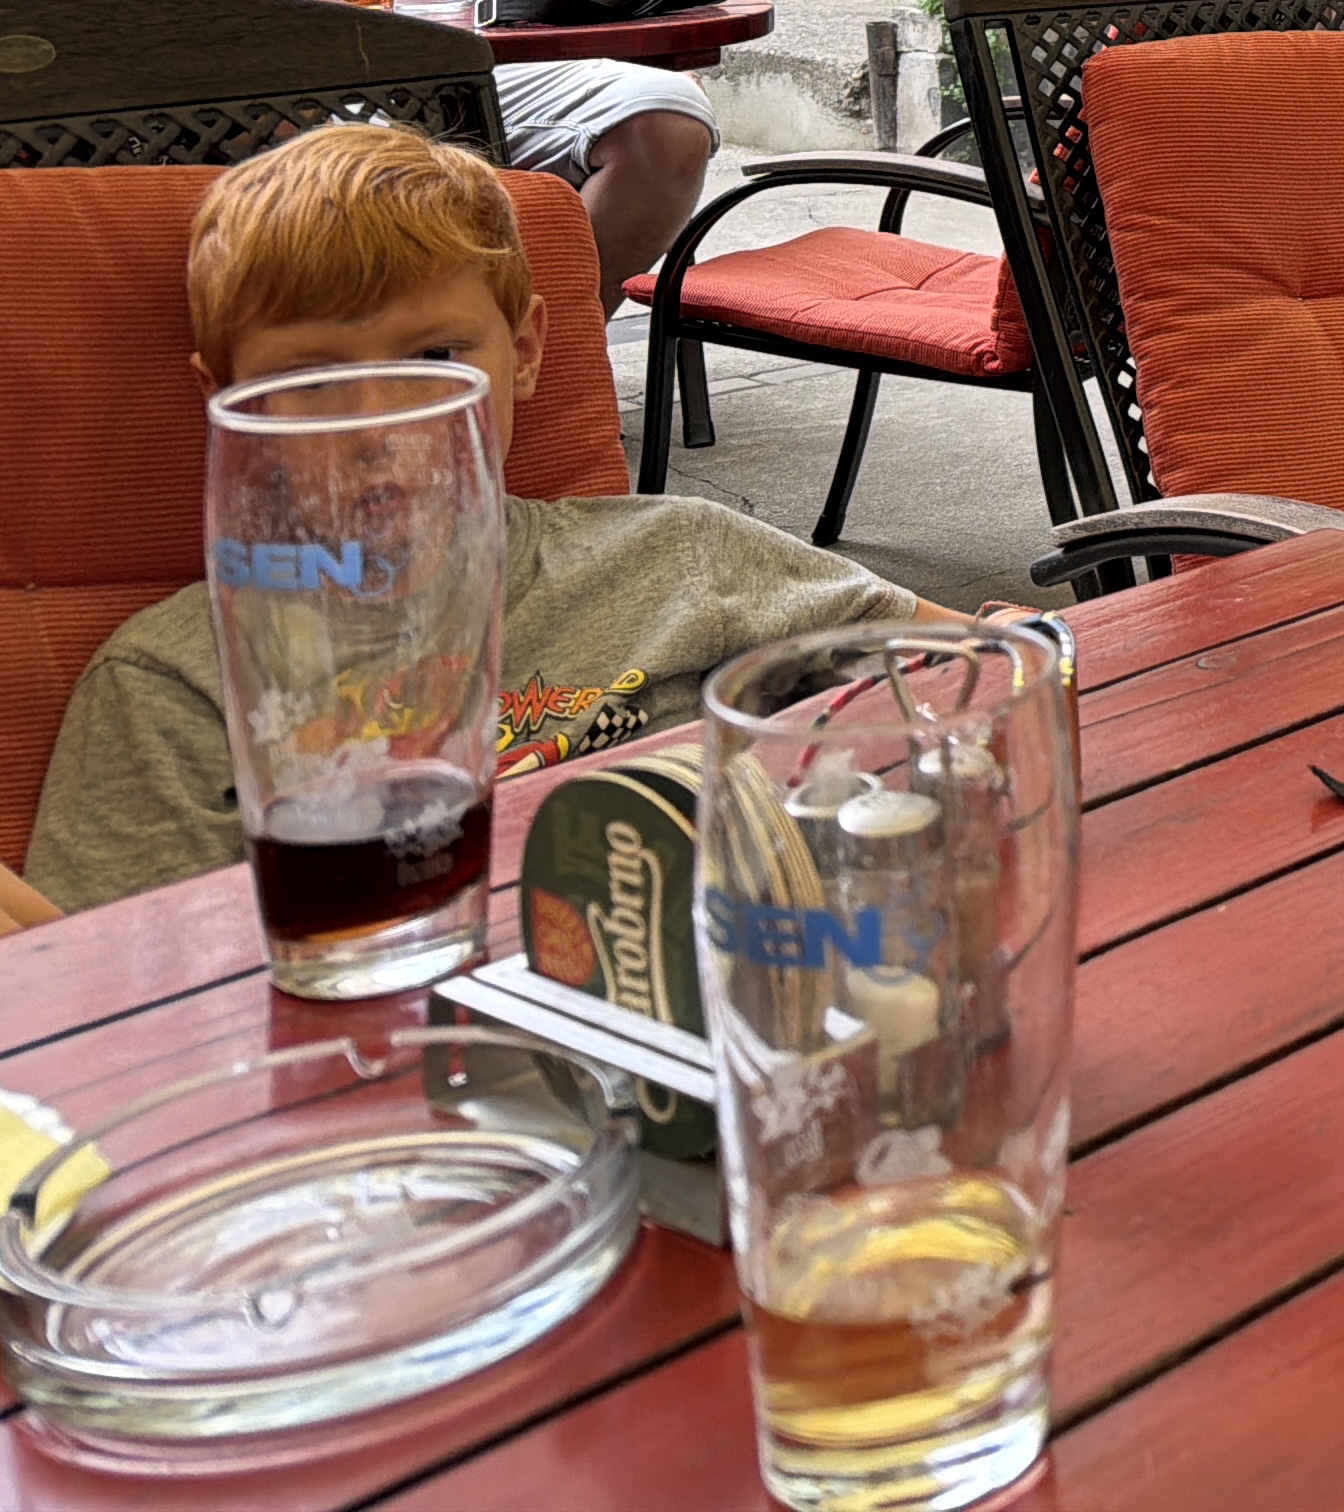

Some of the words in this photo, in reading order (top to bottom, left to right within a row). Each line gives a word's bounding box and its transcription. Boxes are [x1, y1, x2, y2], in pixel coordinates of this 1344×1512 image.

[215, 537, 364, 591] SEN
[497, 671, 604, 732] OWER
[706, 888, 882, 969] SEN
